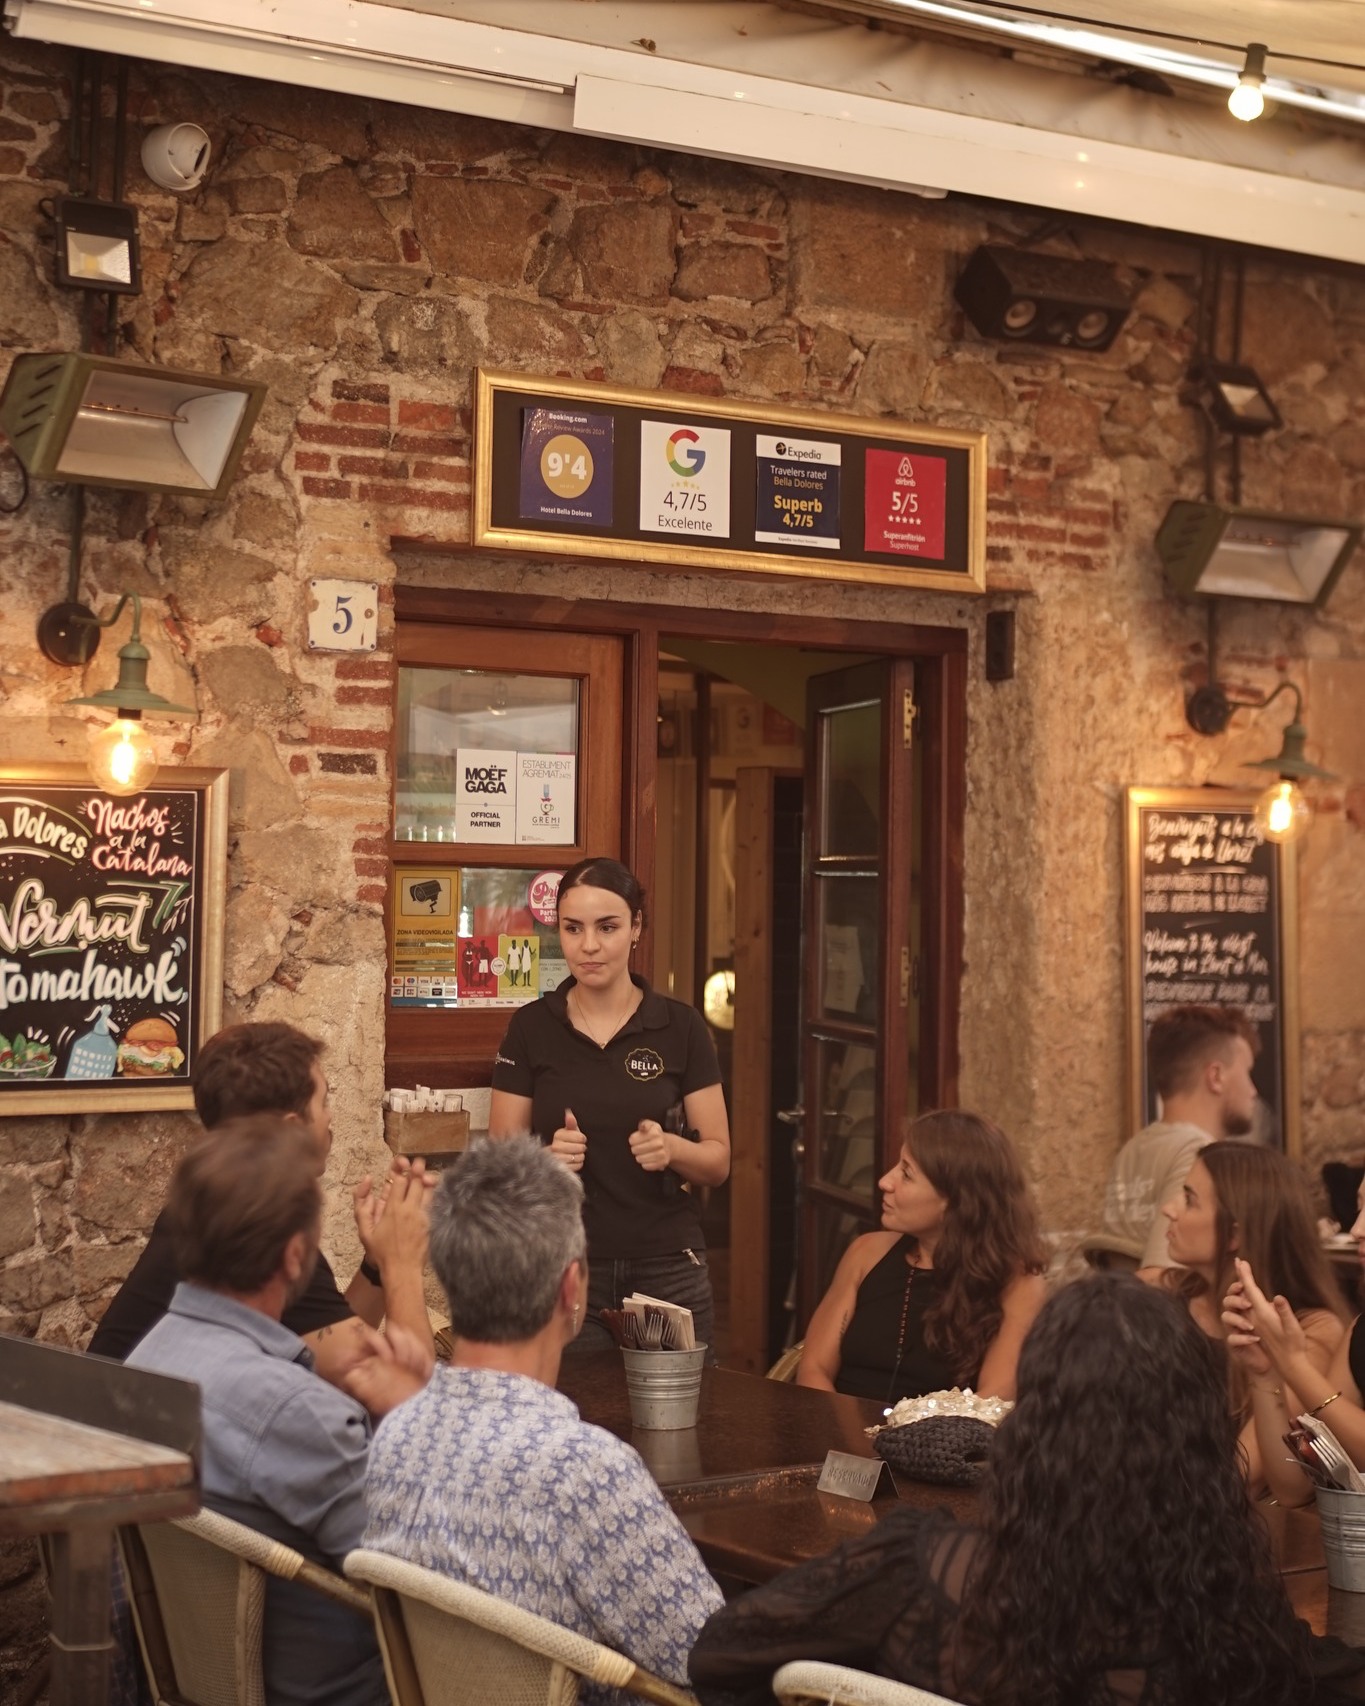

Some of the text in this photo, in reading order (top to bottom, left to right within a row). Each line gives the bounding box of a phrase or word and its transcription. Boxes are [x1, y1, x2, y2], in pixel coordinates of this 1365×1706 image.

[549, 412, 588, 424] Booking.com
[554, 423, 572, 432] Review
[572, 426, 592, 434] Awards
[788, 447, 822, 460] Expedia
[547, 452, 588, 481] 9'4
[770, 465, 828, 480] Travelers rated
[774, 476, 824, 491] Bella Dolores
[895, 478, 916, 488] airbnb
[663, 491, 708, 513] 4,7/5
[774, 495, 823, 514] Superb
[891, 491, 919, 514] 5/5
[540, 506, 593, 518] Hotel Bella Dolores
[658, 515, 713, 532] Excelente
[783, 514, 814, 528] 4,7/5
[883, 530, 926, 543] Superanfitrión
[889, 541, 920, 552] Superhost
[333, 595, 353, 635] 5
[465, 764, 508, 781] MOËF
[522, 769, 559, 778] AGREMIAT
[465, 780, 507, 794] GAGA
[88, 798, 171, 837] Nachos
[471, 811, 501, 819] OFFICIAL
[532, 816, 560, 824] GREMI
[470, 820, 501, 828] PARTNER
[13, 806, 89, 859] Dolores
[109, 829, 147, 852] a la
[92, 842, 193, 876] Catalana
[631, 1060, 659, 1070] BELLA
